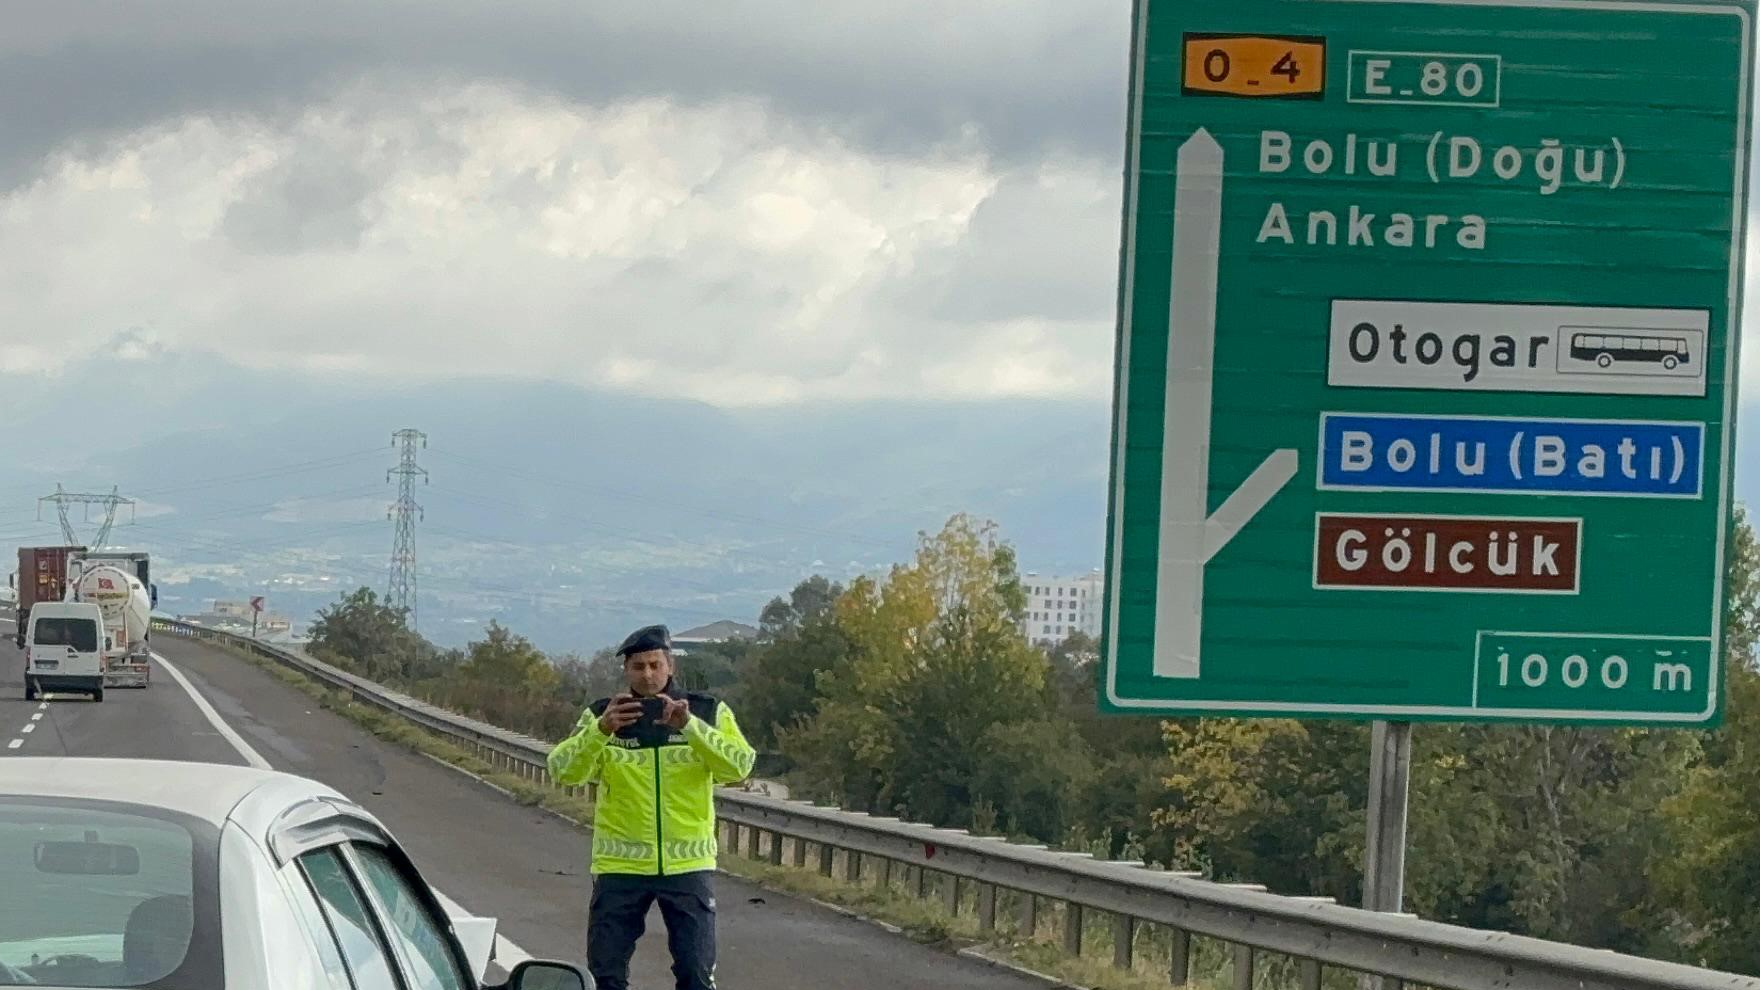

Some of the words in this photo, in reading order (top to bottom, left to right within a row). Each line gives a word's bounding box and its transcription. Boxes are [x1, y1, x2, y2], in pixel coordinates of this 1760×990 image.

[1258, 130, 1397, 177] Bolu
[1426, 131, 1626, 195] (Doğu)
[1256, 202, 1486, 249] Ankara
[1348, 321, 1549, 382] Otogar
[1340, 431, 1485, 475] Bolu
[1508, 431, 1685, 484] (Batı)
[1336, 527, 1560, 575] Gölcük
[1496, 652, 1629, 689] 1000
[1653, 661, 1692, 691] m
